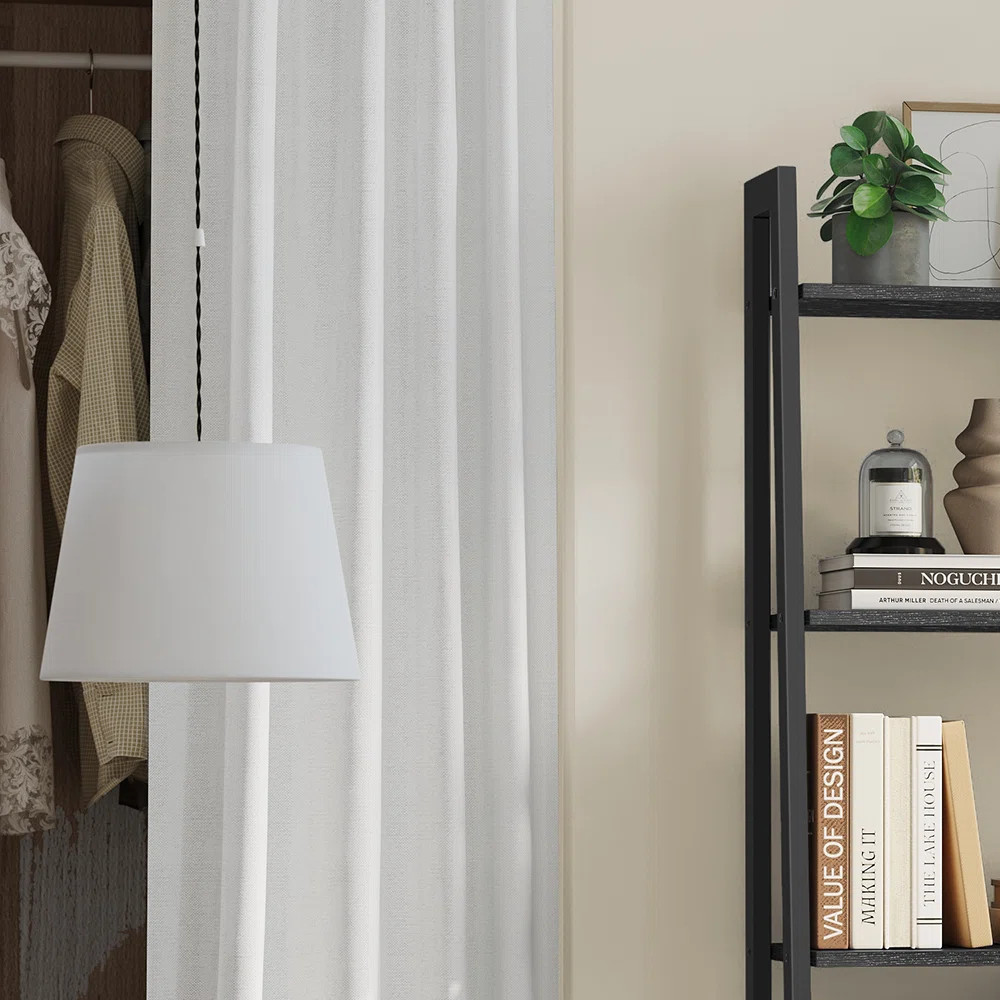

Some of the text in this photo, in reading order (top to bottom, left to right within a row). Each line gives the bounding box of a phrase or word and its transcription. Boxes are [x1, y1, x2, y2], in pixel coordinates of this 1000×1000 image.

[921, 572, 1000, 586] NOGUCHI
[823, 728, 844, 940] VALUE OF DESIGN
[861, 828, 876, 925] MAKING IT
[923, 761, 936, 907] THE LAKE HOUSE
